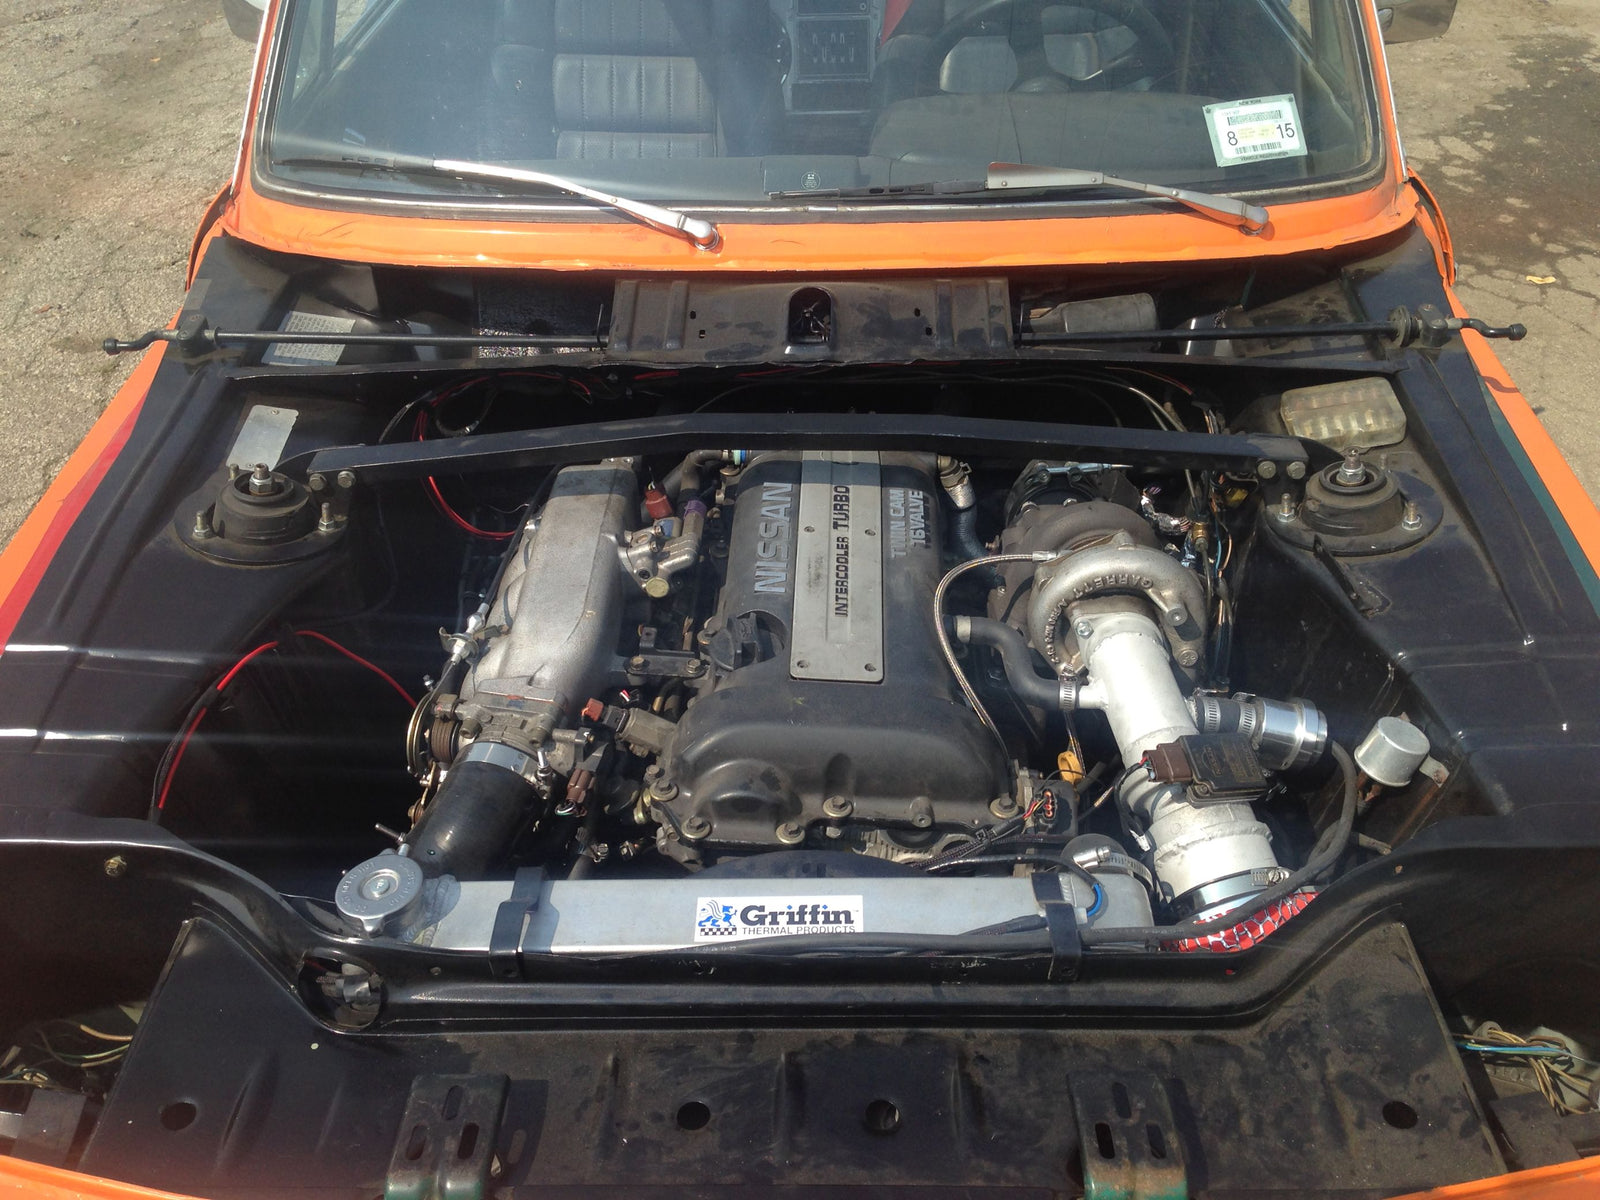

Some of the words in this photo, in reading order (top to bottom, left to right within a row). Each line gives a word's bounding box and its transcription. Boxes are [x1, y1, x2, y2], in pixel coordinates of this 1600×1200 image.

[1226, 131, 1238, 146] 8
[1276, 122, 1295, 139] 15
[832, 484, 850, 530] TURBO
[889, 489, 906, 518] CAM
[908, 490, 926, 546] 16VALVE
[753, 481, 793, 594] NISSAN
[889, 521, 907, 559] TWIN
[834, 535, 850, 618] INTERCOOLER
[1072, 573, 1154, 599] GARRETT
[740, 904, 855, 926] Griffin
[742, 926, 793, 935] THERMAL
[797, 925, 856, 934] PRODUCTS
